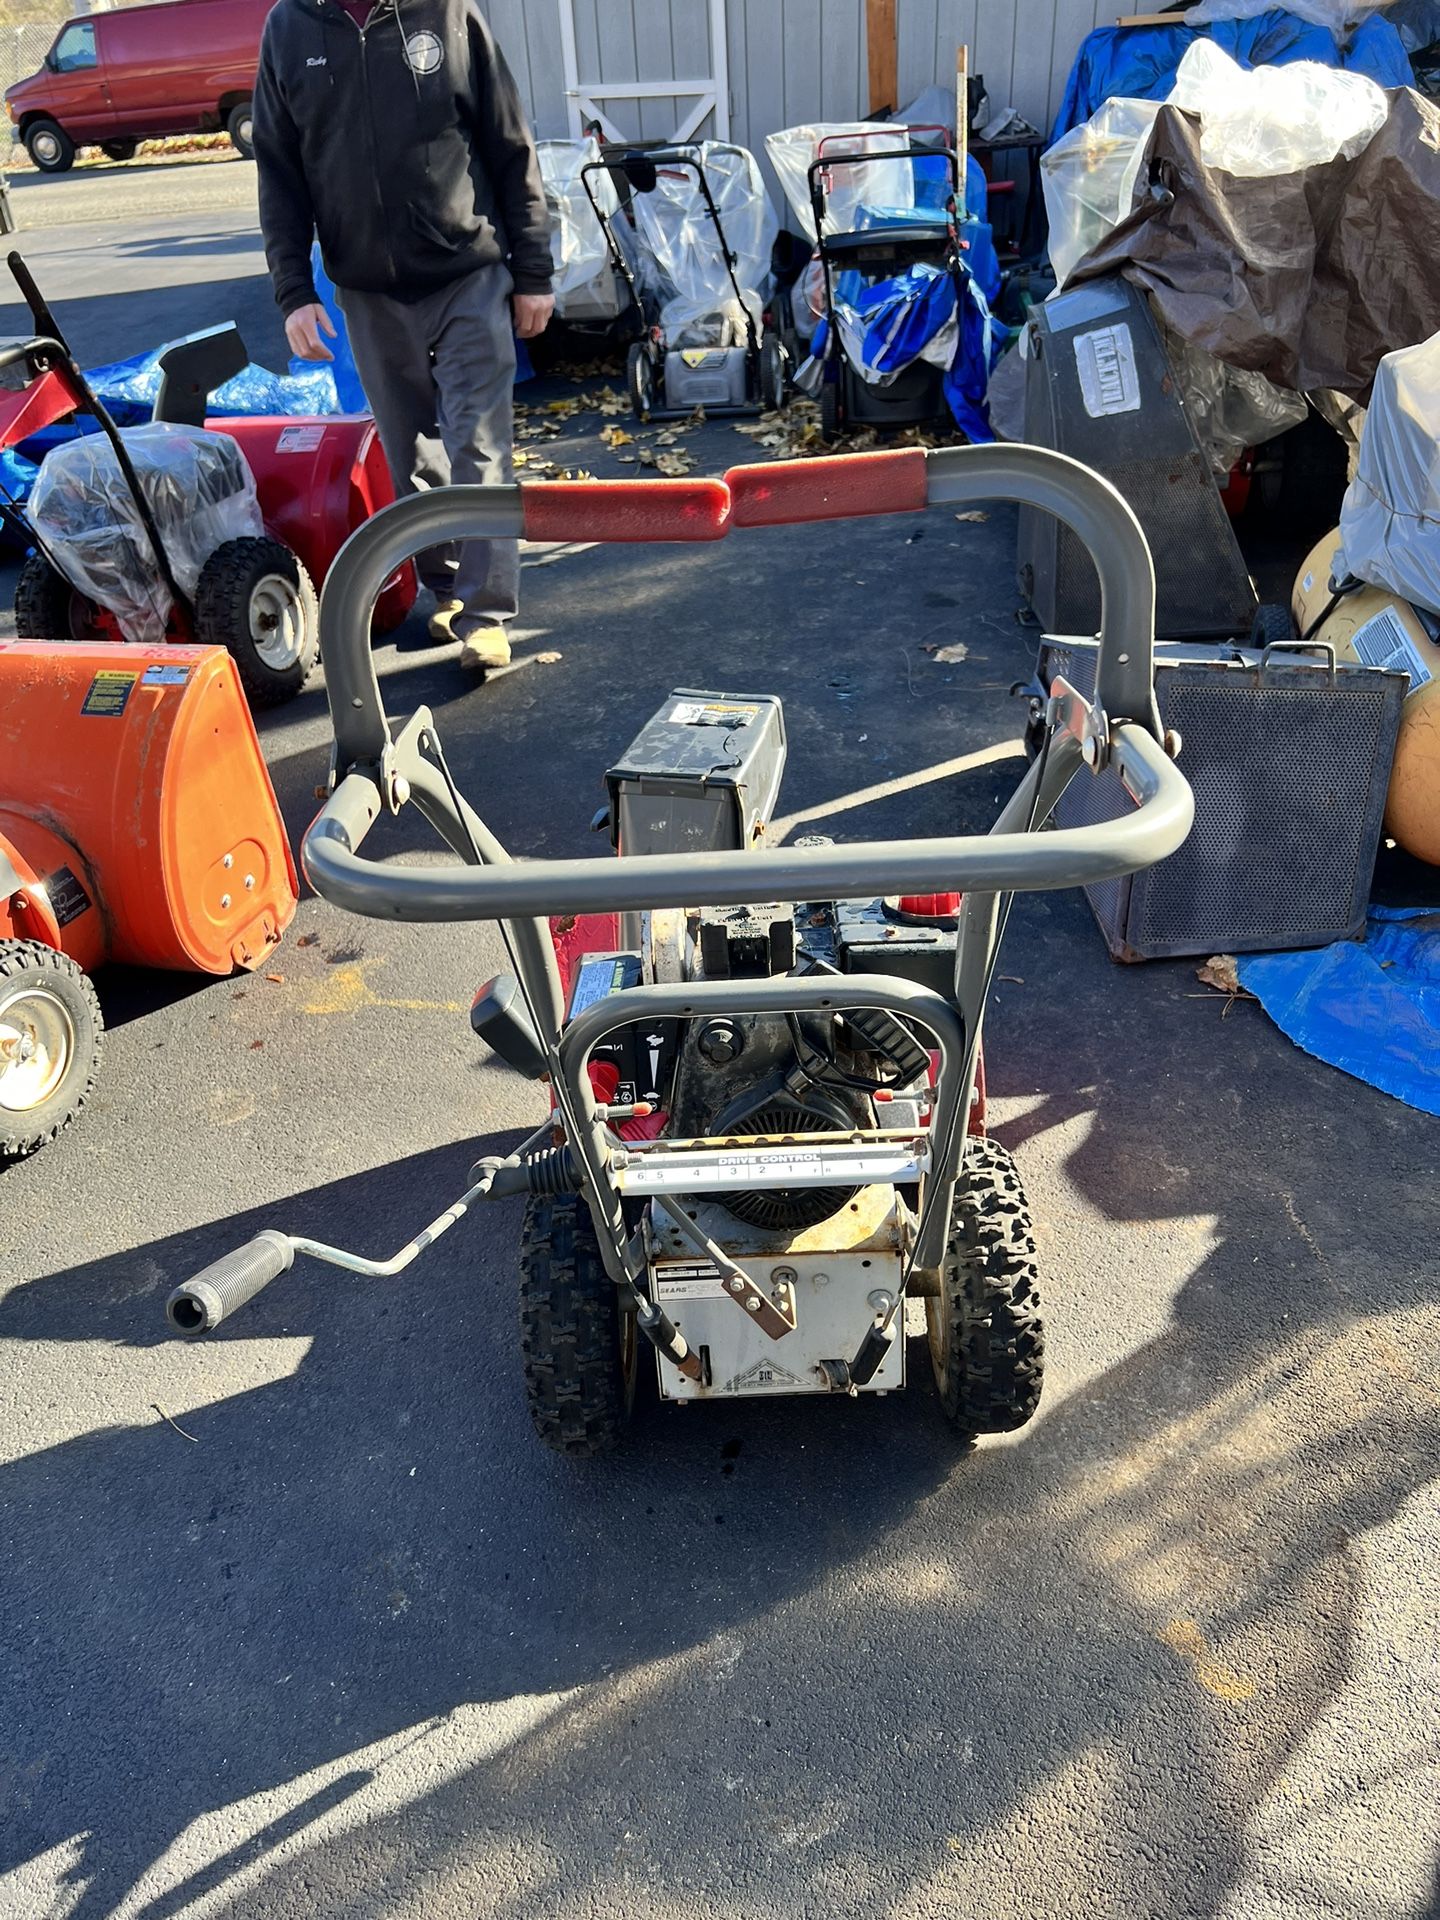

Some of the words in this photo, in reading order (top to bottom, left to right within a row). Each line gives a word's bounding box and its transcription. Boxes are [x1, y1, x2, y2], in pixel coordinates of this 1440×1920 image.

[718, 1156, 757, 1166] DRIVE
[760, 1153, 821, 1164] CONTROL
[637, 1172, 645, 1180] 6
[657, 1171, 664, 1179] 5
[693, 1169, 700, 1177] 4
[730, 1167, 737, 1176] 3
[759, 1166, 766, 1174] 2
[788, 1164, 793, 1172] 1
[906, 1160, 913, 1168] 2
[660, 1286, 687, 1294] SEARS
